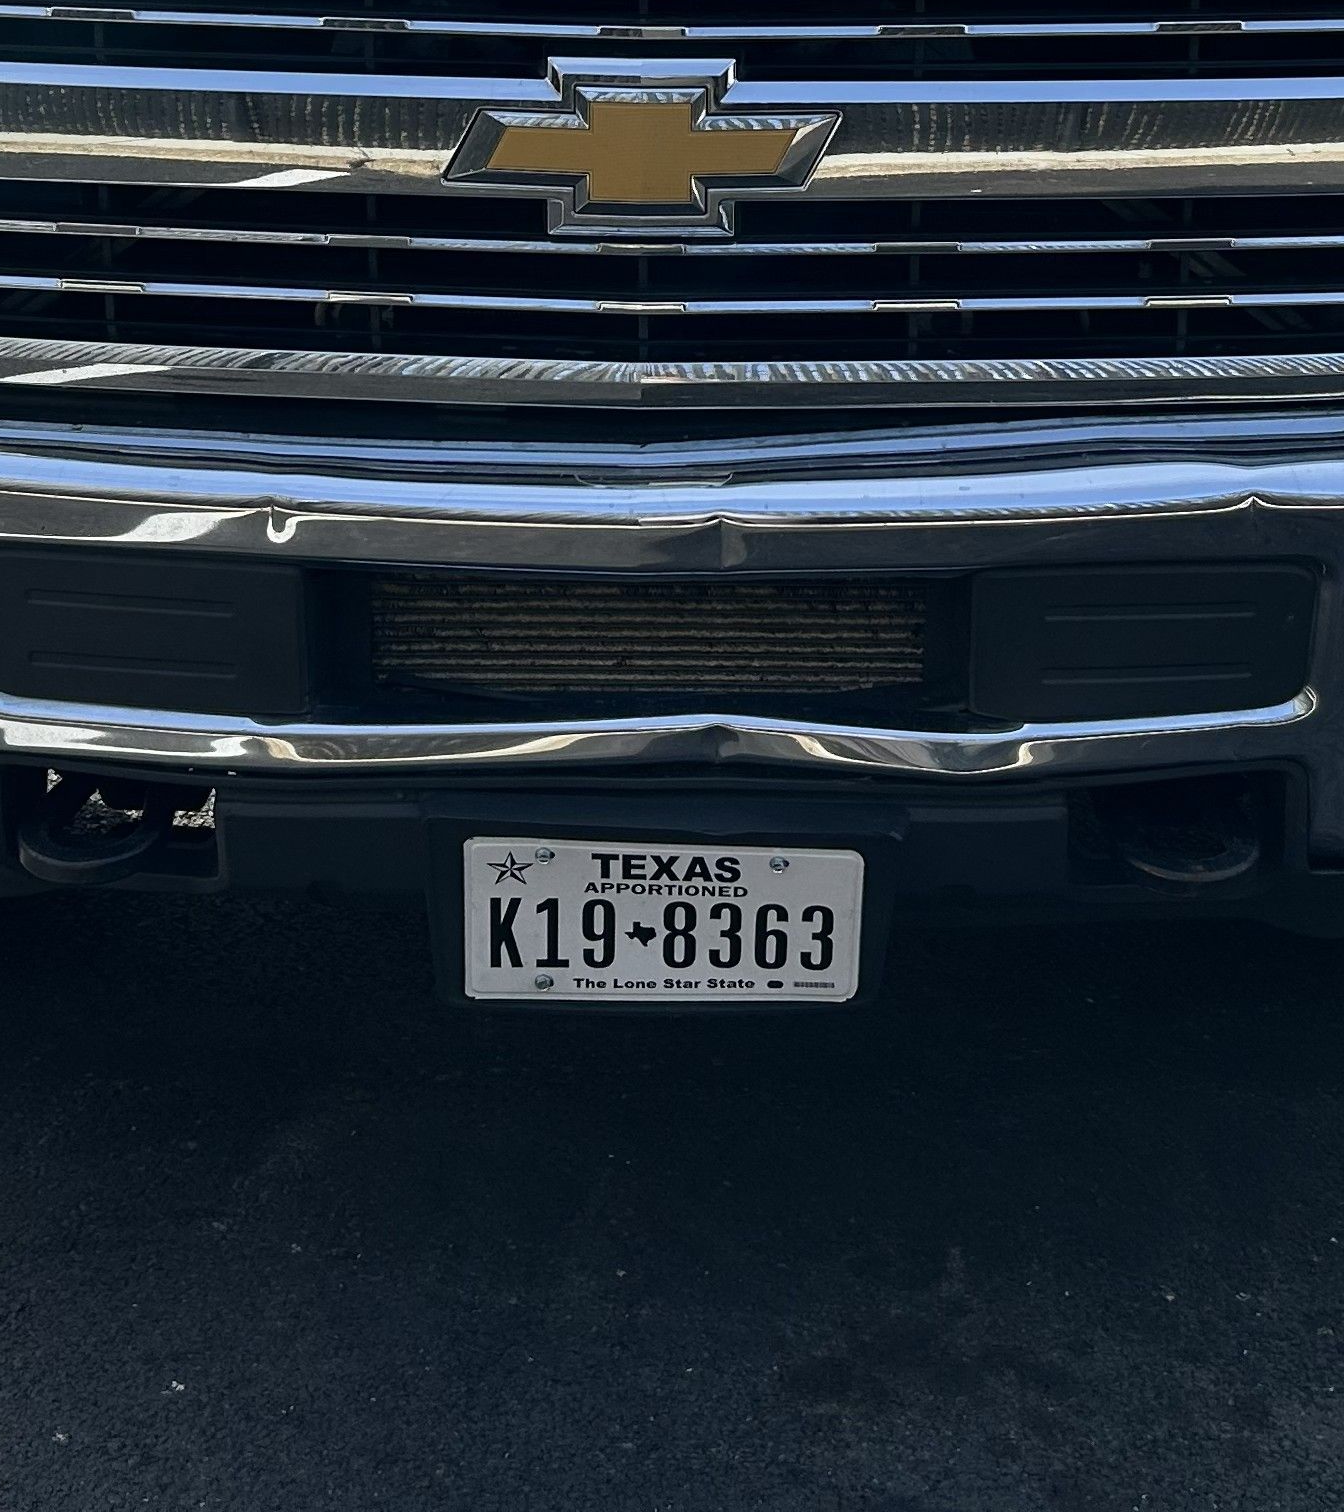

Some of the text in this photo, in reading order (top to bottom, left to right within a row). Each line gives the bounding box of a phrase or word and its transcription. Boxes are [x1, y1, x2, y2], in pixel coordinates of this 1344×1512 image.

[591, 852, 742, 884] TEXAS
[583, 881, 749, 898] APPORTIONED
[573, 977, 756, 989] The Lone Star State
